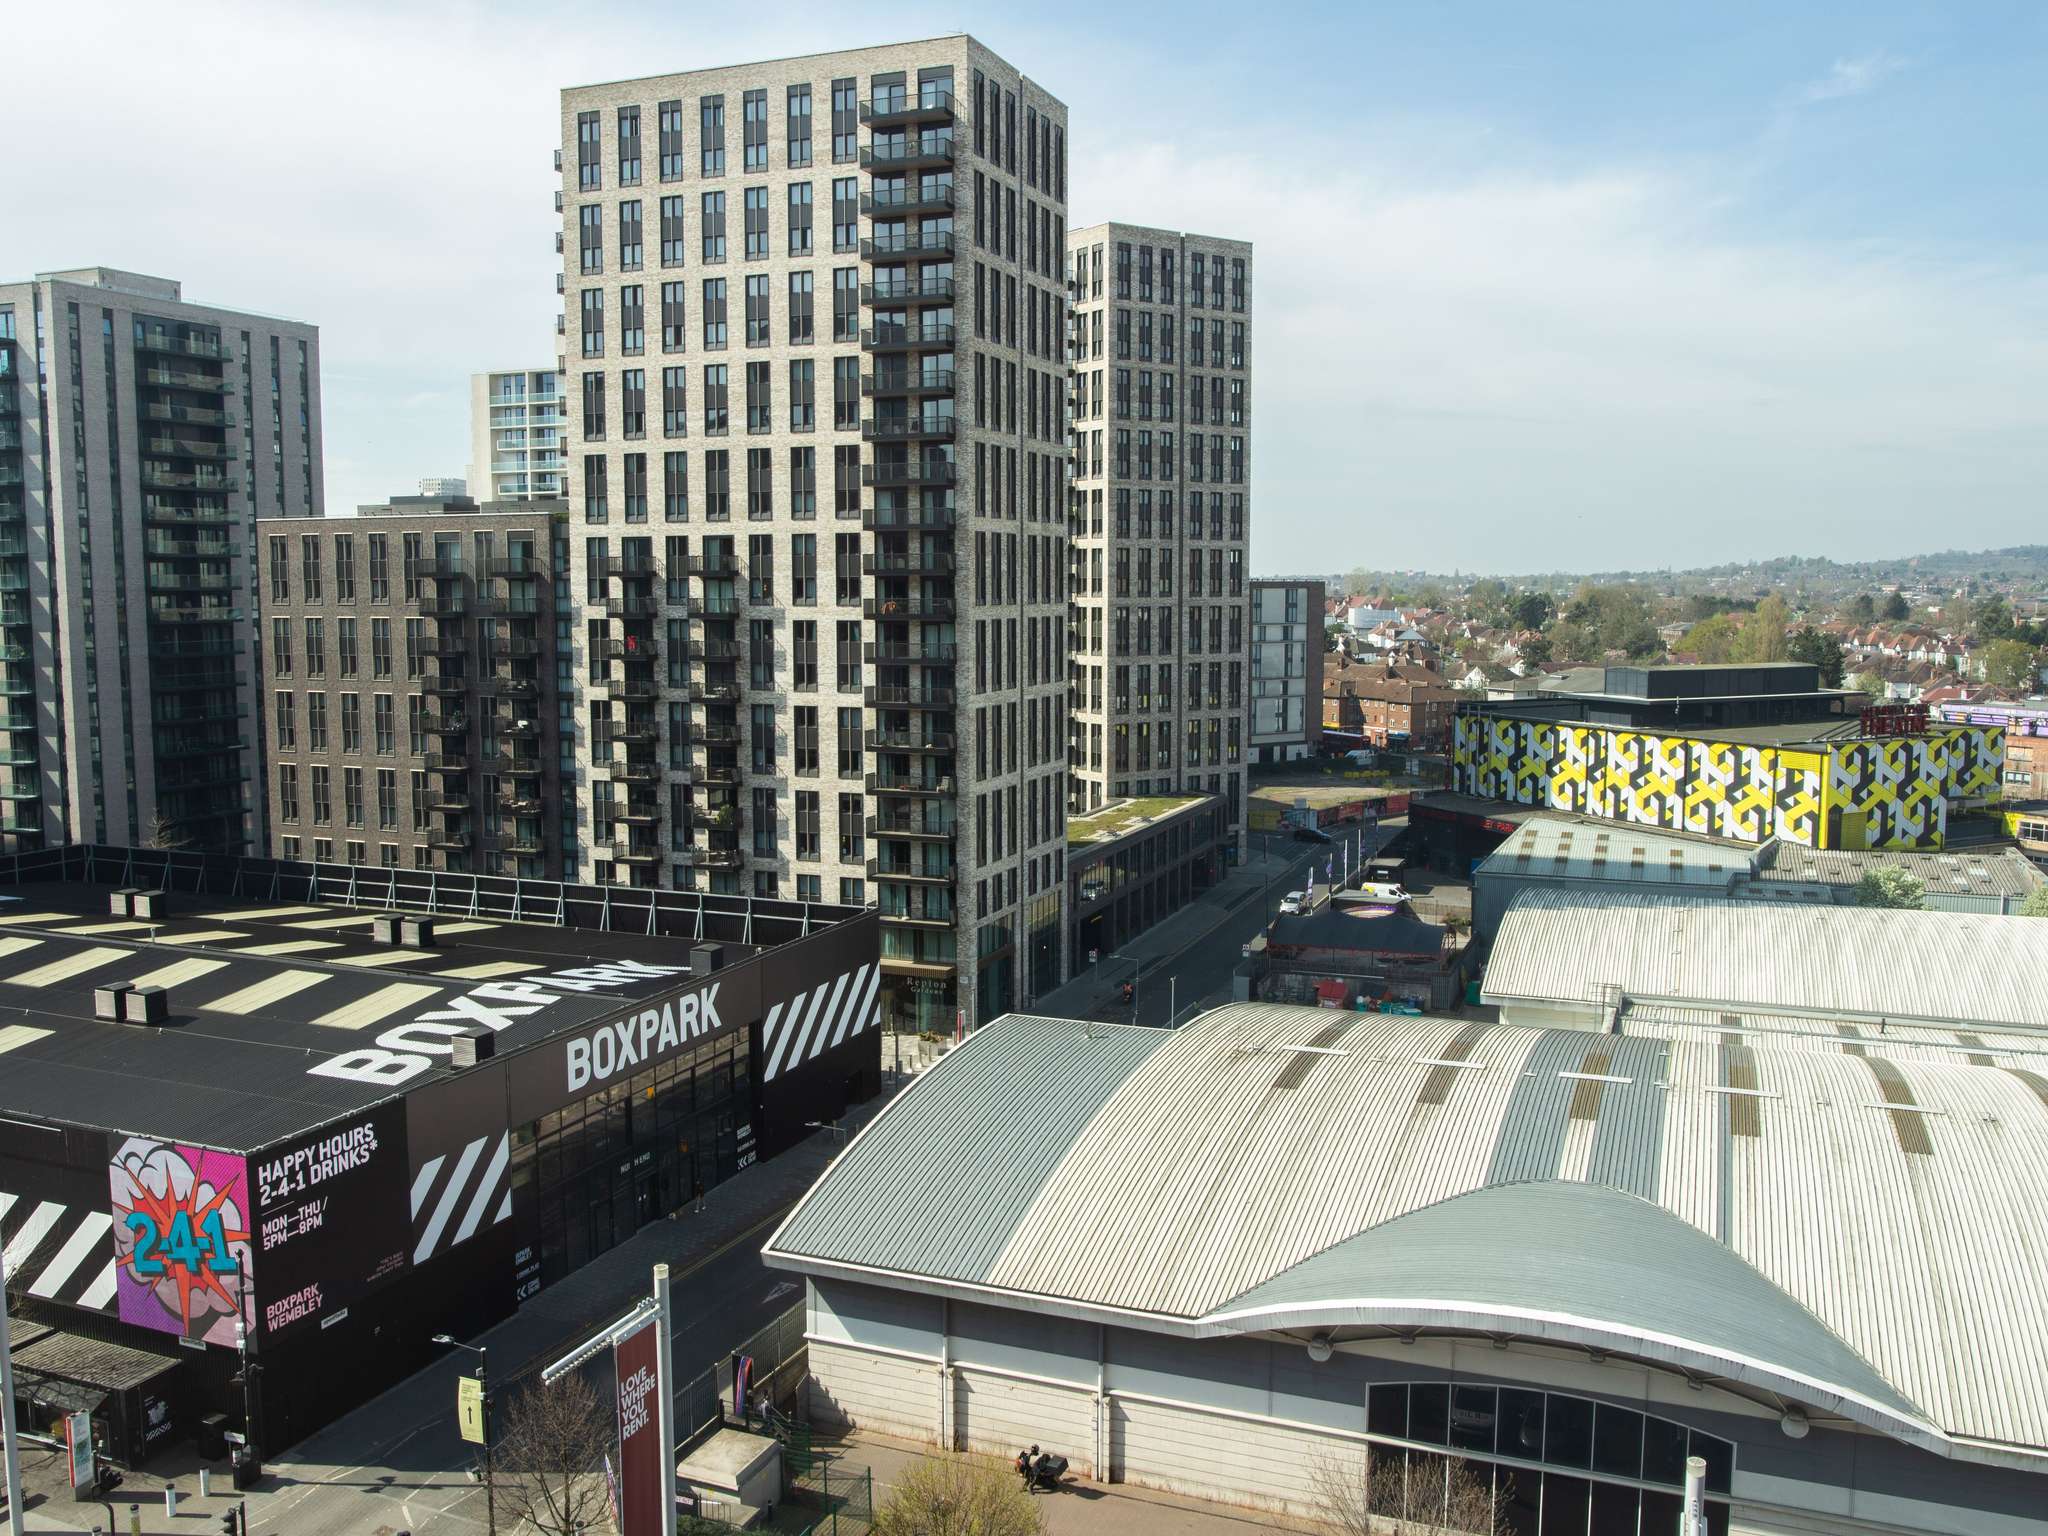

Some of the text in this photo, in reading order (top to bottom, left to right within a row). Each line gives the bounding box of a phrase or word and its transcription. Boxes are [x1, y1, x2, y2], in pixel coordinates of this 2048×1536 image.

[906, 976, 947, 989] Repton
[306, 959, 691, 1086] BOXPARK
[566, 982, 722, 1093] BOXPARK
[258, 1122, 374, 1186] HAPPY HOURS
[259, 1171, 307, 1207] 2-4-1
[266, 1282, 319, 1320] BOXPARK
[267, 1294, 323, 1333] WEMBLEY
[620, 1365, 648, 1396] LOVE
[620, 1373, 656, 1411] WHERE
[622, 1398, 645, 1425] YOU
[623, 1409, 649, 1441] RENT.
